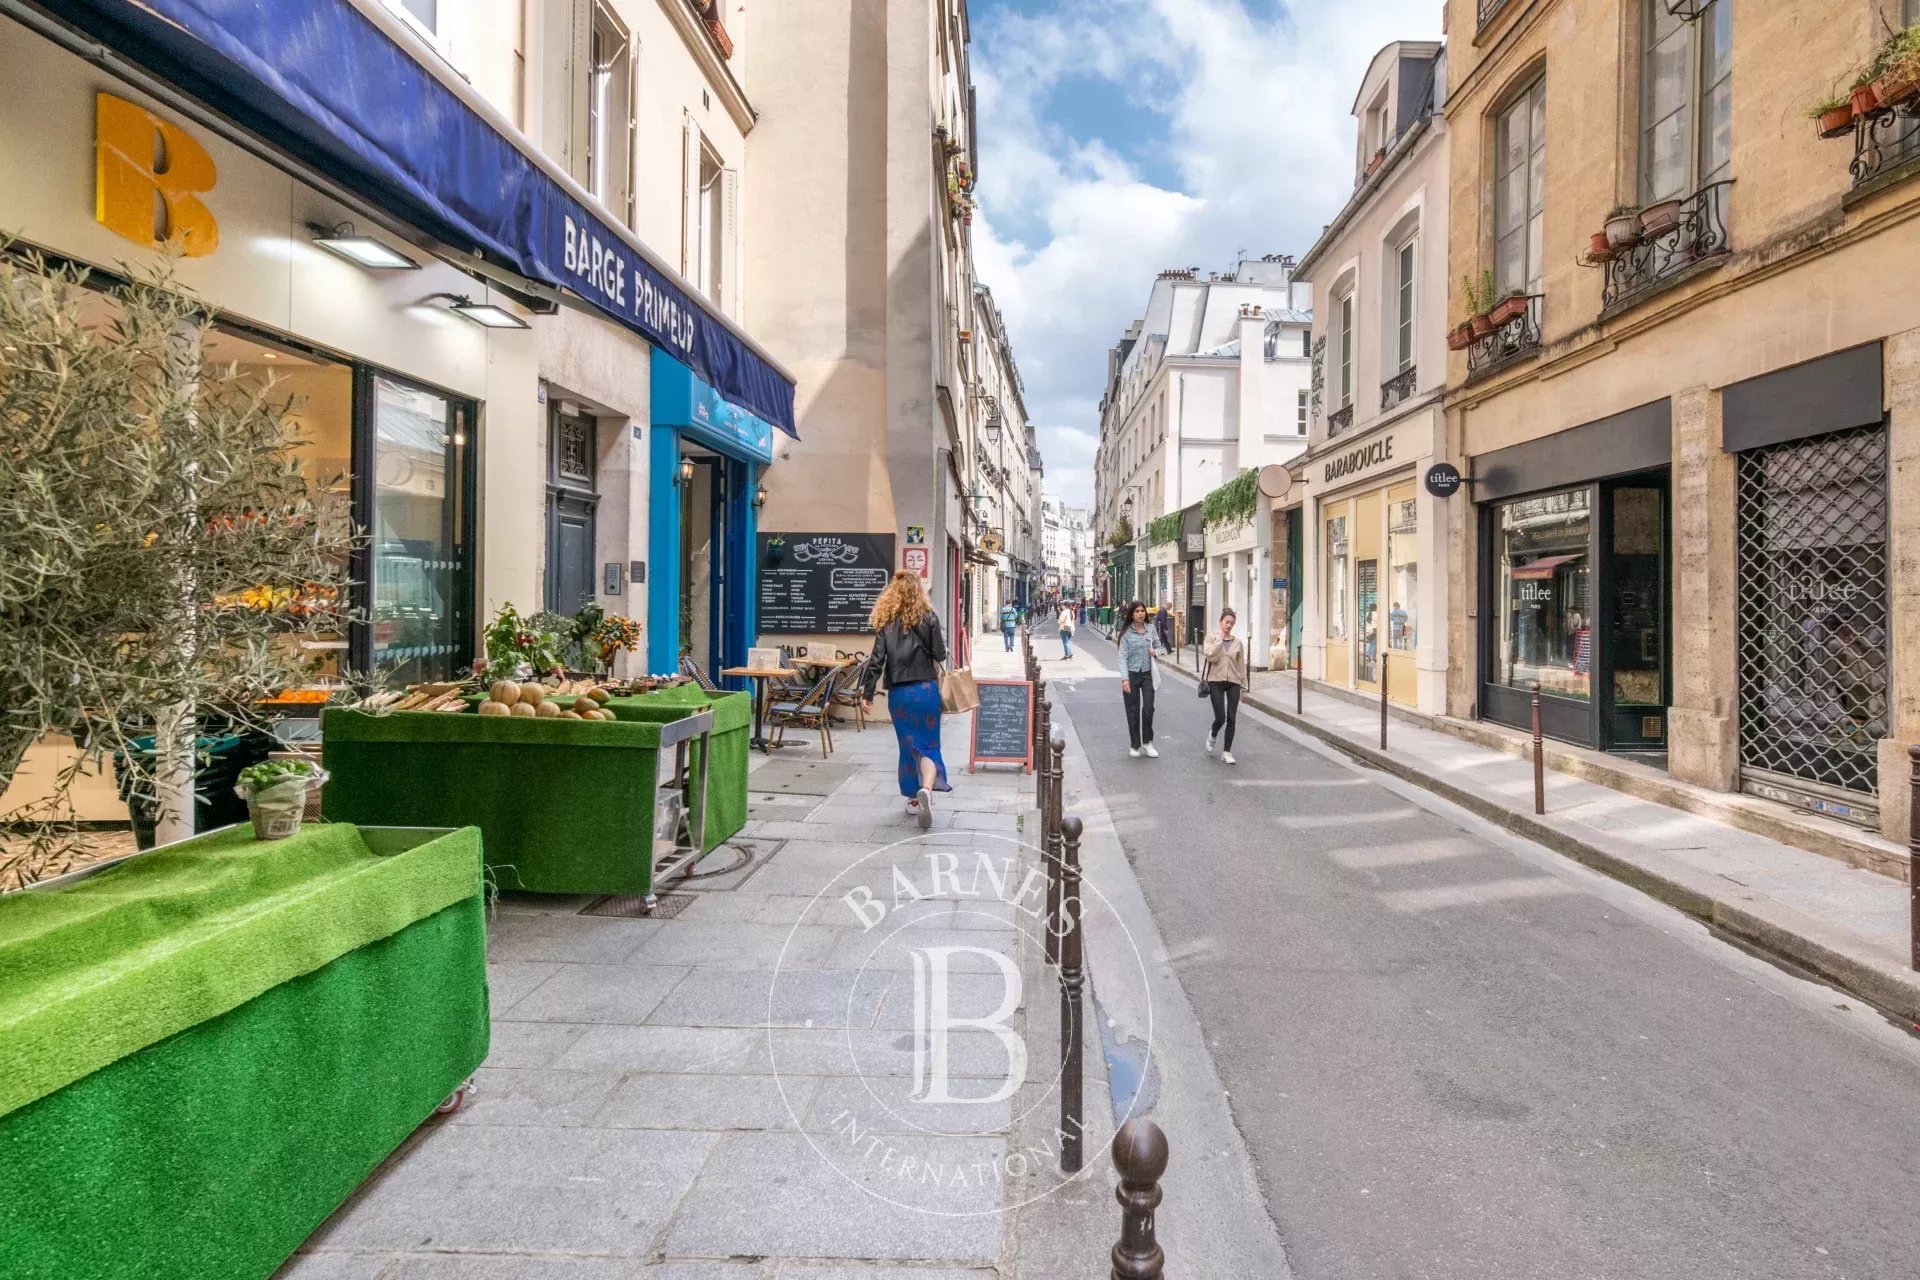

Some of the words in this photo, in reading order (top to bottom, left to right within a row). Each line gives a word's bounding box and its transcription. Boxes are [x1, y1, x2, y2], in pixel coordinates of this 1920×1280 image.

[96, 92, 219, 260] B
[564, 214, 625, 307] BARGE
[634, 270, 694, 354] PRIMEUR
[1325, 436, 1393, 482] BARABOUCLE
[1430, 472, 1458, 483] titlee
[812, 537, 842, 545] PEPITA
[1521, 582, 1551, 600] titlee
